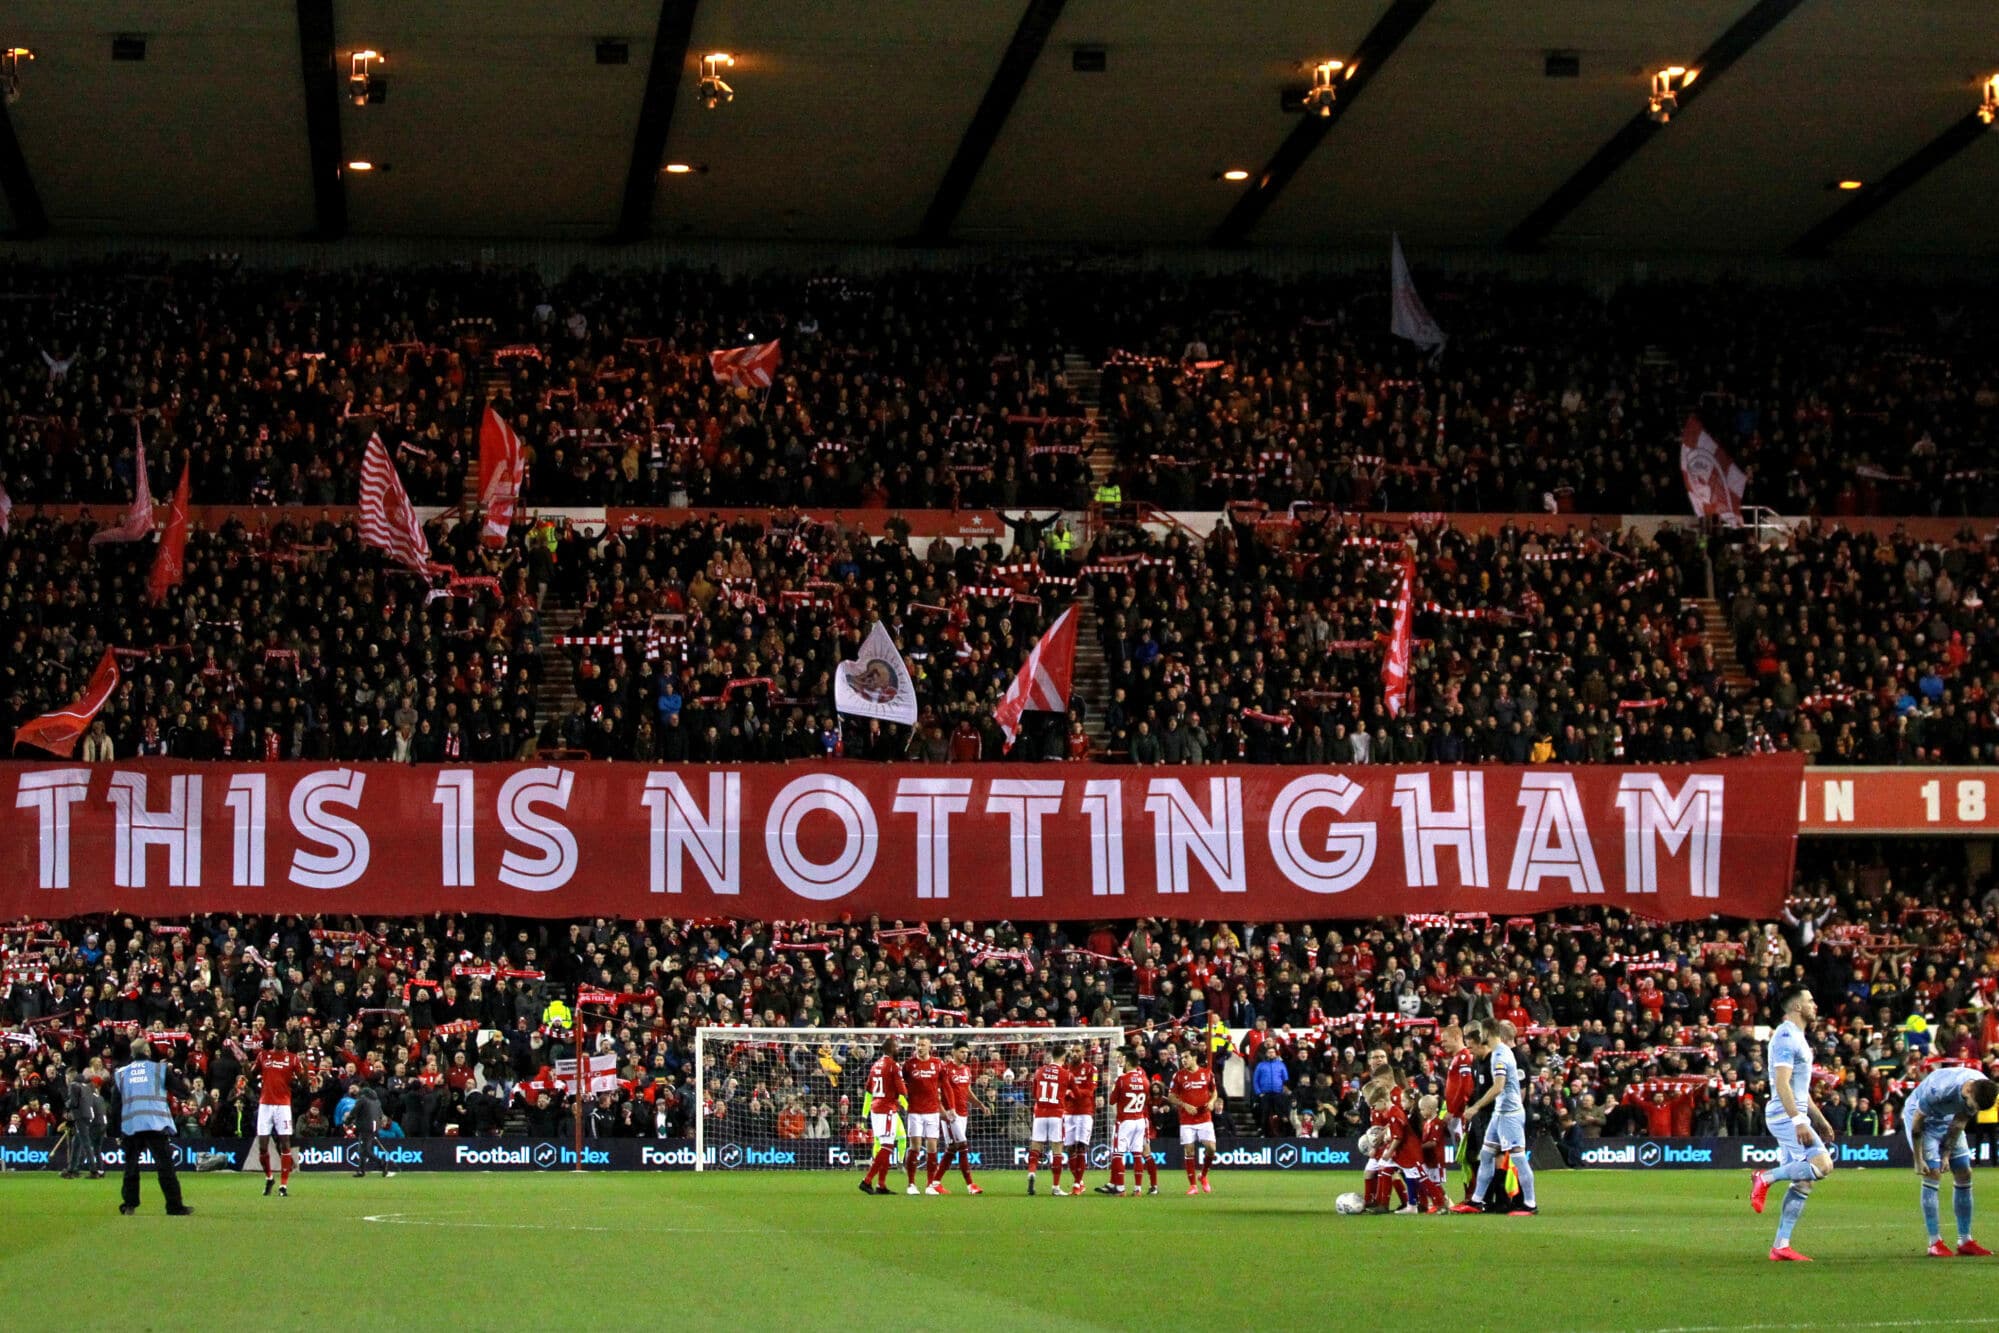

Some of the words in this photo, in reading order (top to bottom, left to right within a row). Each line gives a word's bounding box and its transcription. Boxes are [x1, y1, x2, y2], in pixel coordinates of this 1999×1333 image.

[1921, 780, 1986, 821] 18
[16, 767, 370, 889] THIS
[433, 765, 578, 891] IS
[641, 770, 1724, 899] NOTTINGHAM
[1039, 1080, 1060, 1104] 11
[1123, 1092, 1146, 1113] 28
[456, 1145, 530, 1163] Football
[561, 1146, 609, 1163] Index
[746, 1147, 796, 1164] Index
[1198, 1146, 1271, 1164] Football
[1301, 1147, 1350, 1163] Index
[1581, 1145, 1636, 1163] otball
[1664, 1145, 1712, 1162] Index
[1841, 1144, 1889, 1161] Index
